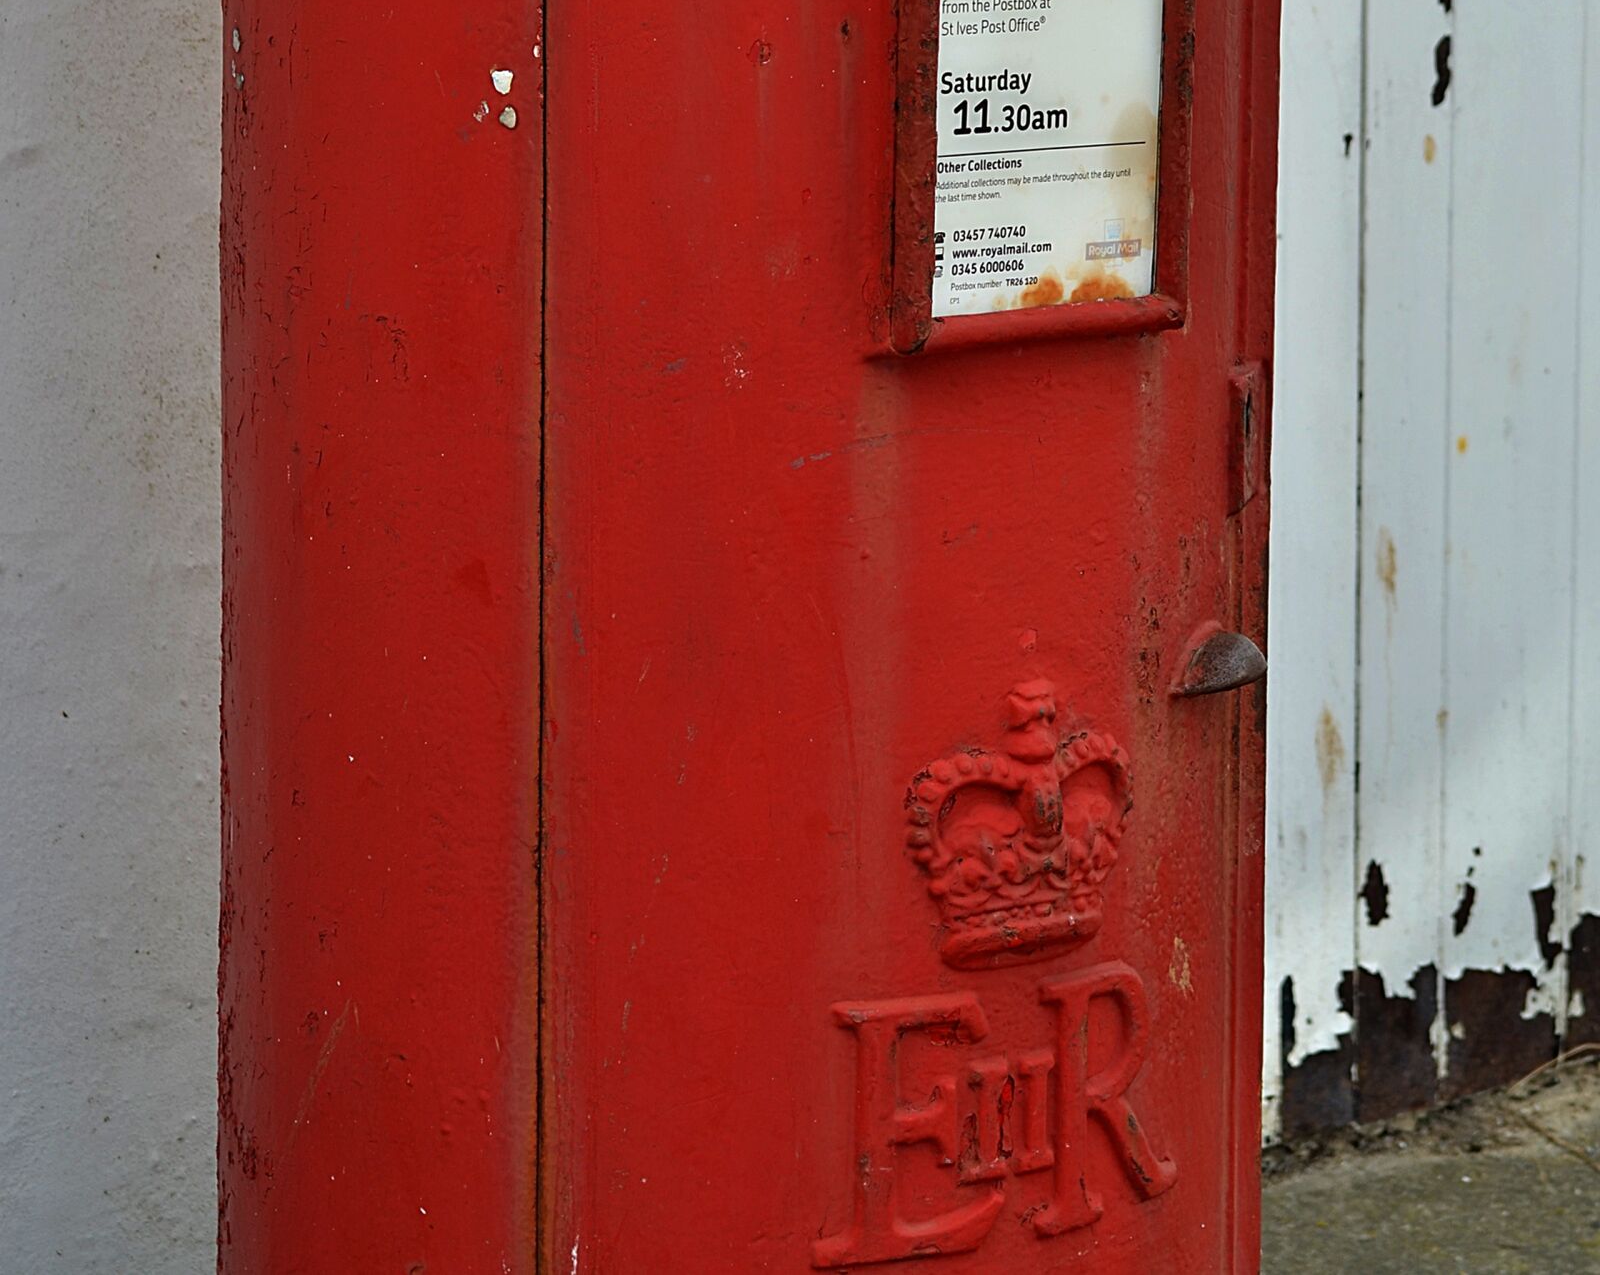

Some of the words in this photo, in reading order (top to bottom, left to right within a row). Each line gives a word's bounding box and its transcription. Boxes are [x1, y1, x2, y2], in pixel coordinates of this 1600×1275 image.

[942, 0, 969, 13] from
[941, 20, 954, 36] St
[956, 20, 978, 35] Ives
[981, 19, 1006, 34] Post
[940, 69, 1032, 95] Saturday
[953, 98, 1068, 136] 11.30am
[937, 161, 966, 174] Other
[968, 158, 1022, 171] Collections
[935, 179, 970, 190] Additional
[970, 178, 1006, 188] collections
[1007, 177, 1022, 186] may
[1023, 175, 1031, 184] be
[1032, 174, 1051, 183] made
[1052, 171, 1090, 182] throughout
[1090, 170, 1102, 179] the
[1103, 168, 1115, 179] day
[1115, 167, 1131, 177] until
[935, 195, 946, 203] the
[947, 194, 960, 202] last
[961, 192, 977, 201] time
[978, 191, 1002, 201] shown.
[953, 228, 985, 242] 03457
[988, 226, 1026, 240] 740740
[952, 242, 1052, 259] www.royalmail.com
[1088, 243, 1116, 257] Royal
[1117, 241, 1139, 254] Mail
[951, 263, 977, 276] 0345
[979, 259, 1024, 274] 6000606
[950, 281, 976, 291] Postbox
[977, 279, 1002, 289] number
[1006, 277, 1023, 287] TR26
[1024, 276, 1038, 286] 120
